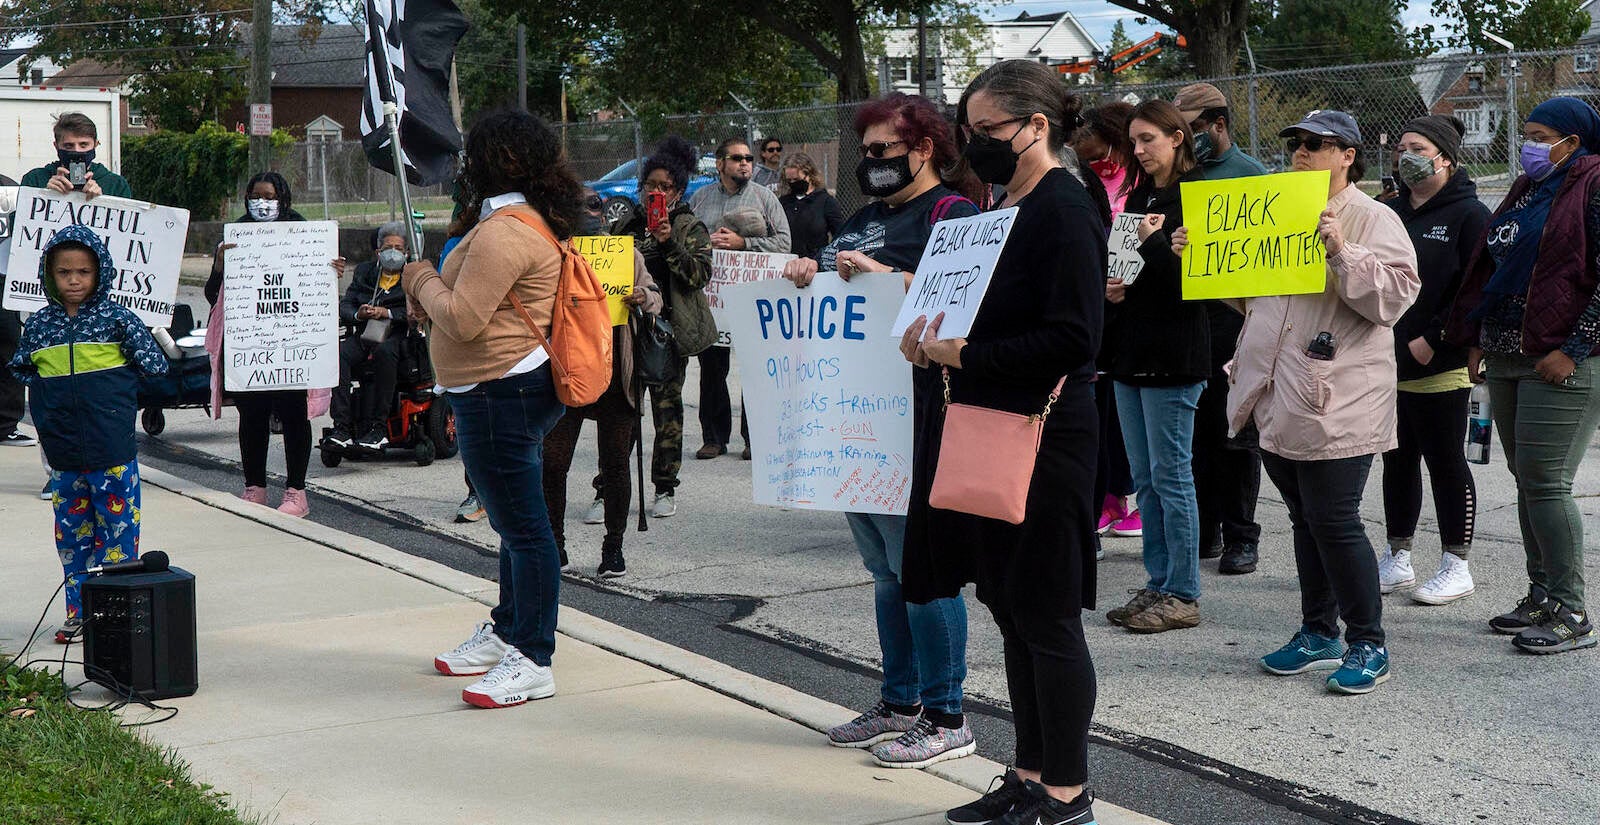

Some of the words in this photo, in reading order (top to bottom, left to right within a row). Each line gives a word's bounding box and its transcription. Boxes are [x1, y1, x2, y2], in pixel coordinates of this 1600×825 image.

[29, 196, 146, 236] PEACEFUL
[1207, 190, 1280, 234] BLACK
[931, 224, 972, 257] BLACK
[970, 216, 1010, 247] LIVES
[1121, 234, 1138, 251] FOR
[126, 238, 153, 265] IN
[579, 237, 625, 255] LIVES
[1188, 238, 1251, 278] LIVES
[1254, 228, 1323, 270] MATTER
[264, 273, 284, 286] SAY
[742, 269, 760, 282] OUR
[257, 287, 291, 300] THEIR
[914, 265, 981, 309] MATTER
[256, 301, 300, 314] NAMES
[756, 295, 866, 340] POLICE
[234, 351, 274, 368] BLACK
[284, 348, 318, 362] LIVES
[247, 368, 310, 386] MATTER!
[840, 420, 873, 436] GUN
[511, 672, 522, 680] FILA
